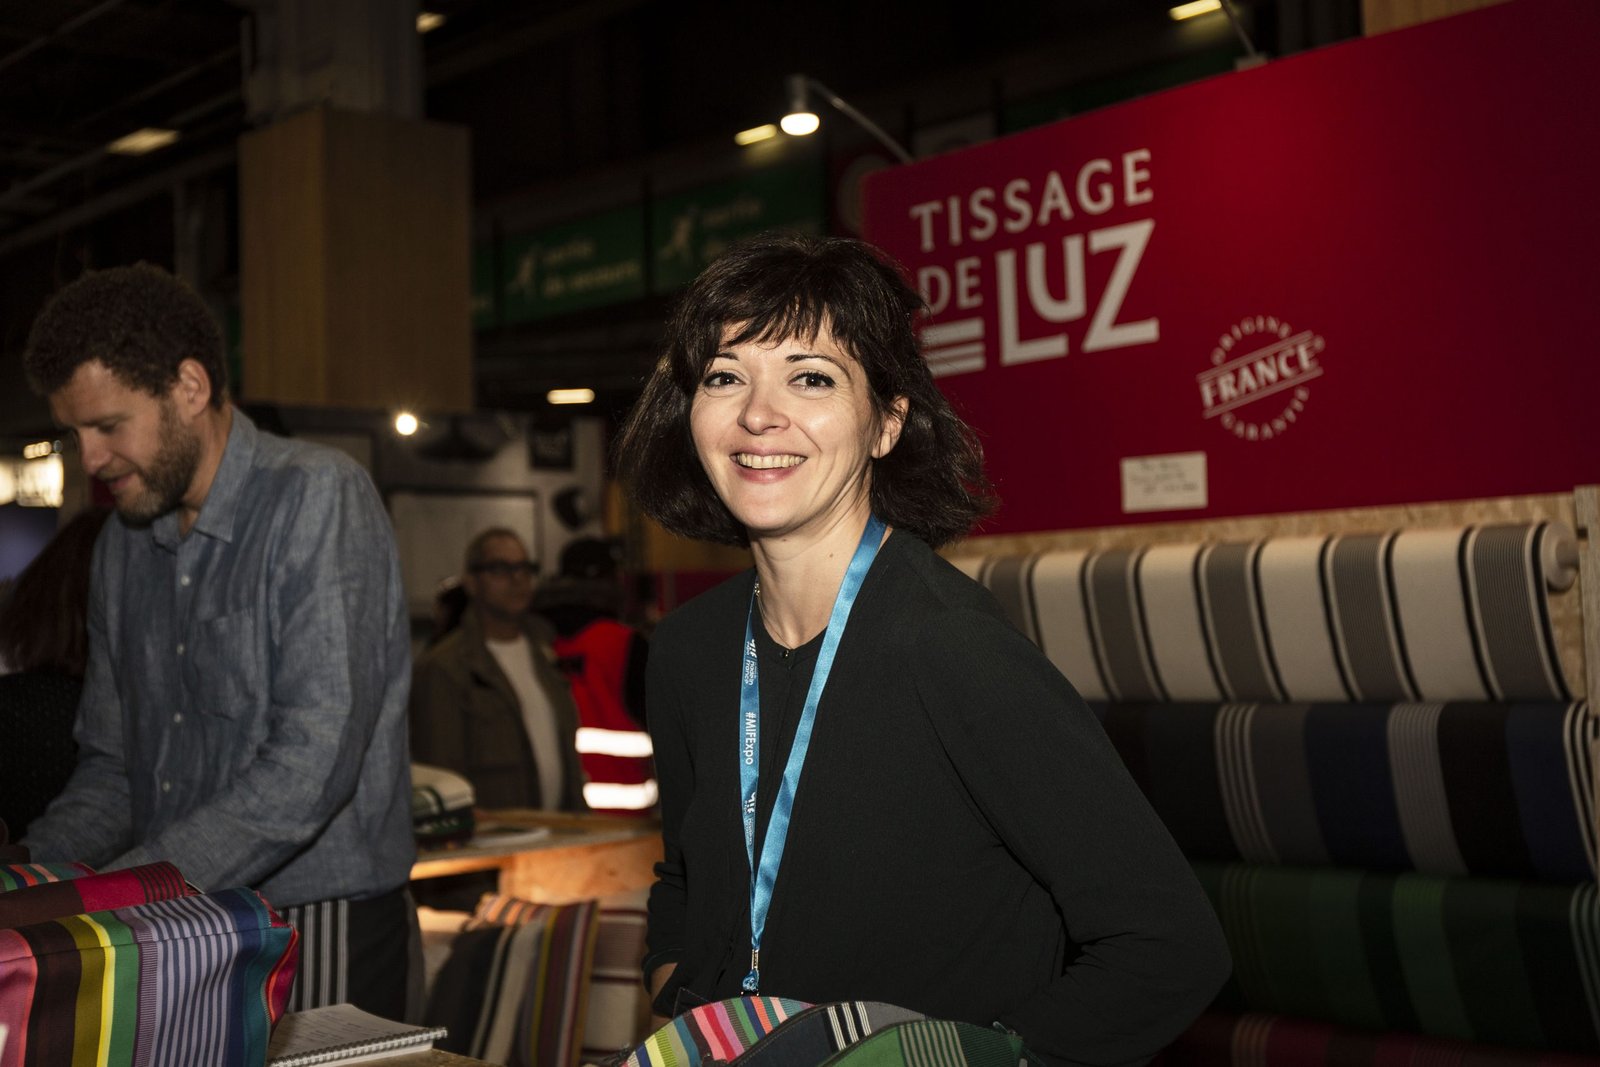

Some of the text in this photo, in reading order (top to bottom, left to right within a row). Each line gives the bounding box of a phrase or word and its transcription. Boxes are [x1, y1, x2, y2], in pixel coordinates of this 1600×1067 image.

[909, 148, 1154, 252] TISSAGE
[916, 217, 1160, 366] DE LUZ
[1200, 338, 1320, 409] FRANCE
[743, 712, 757, 765] #MIFExpo
